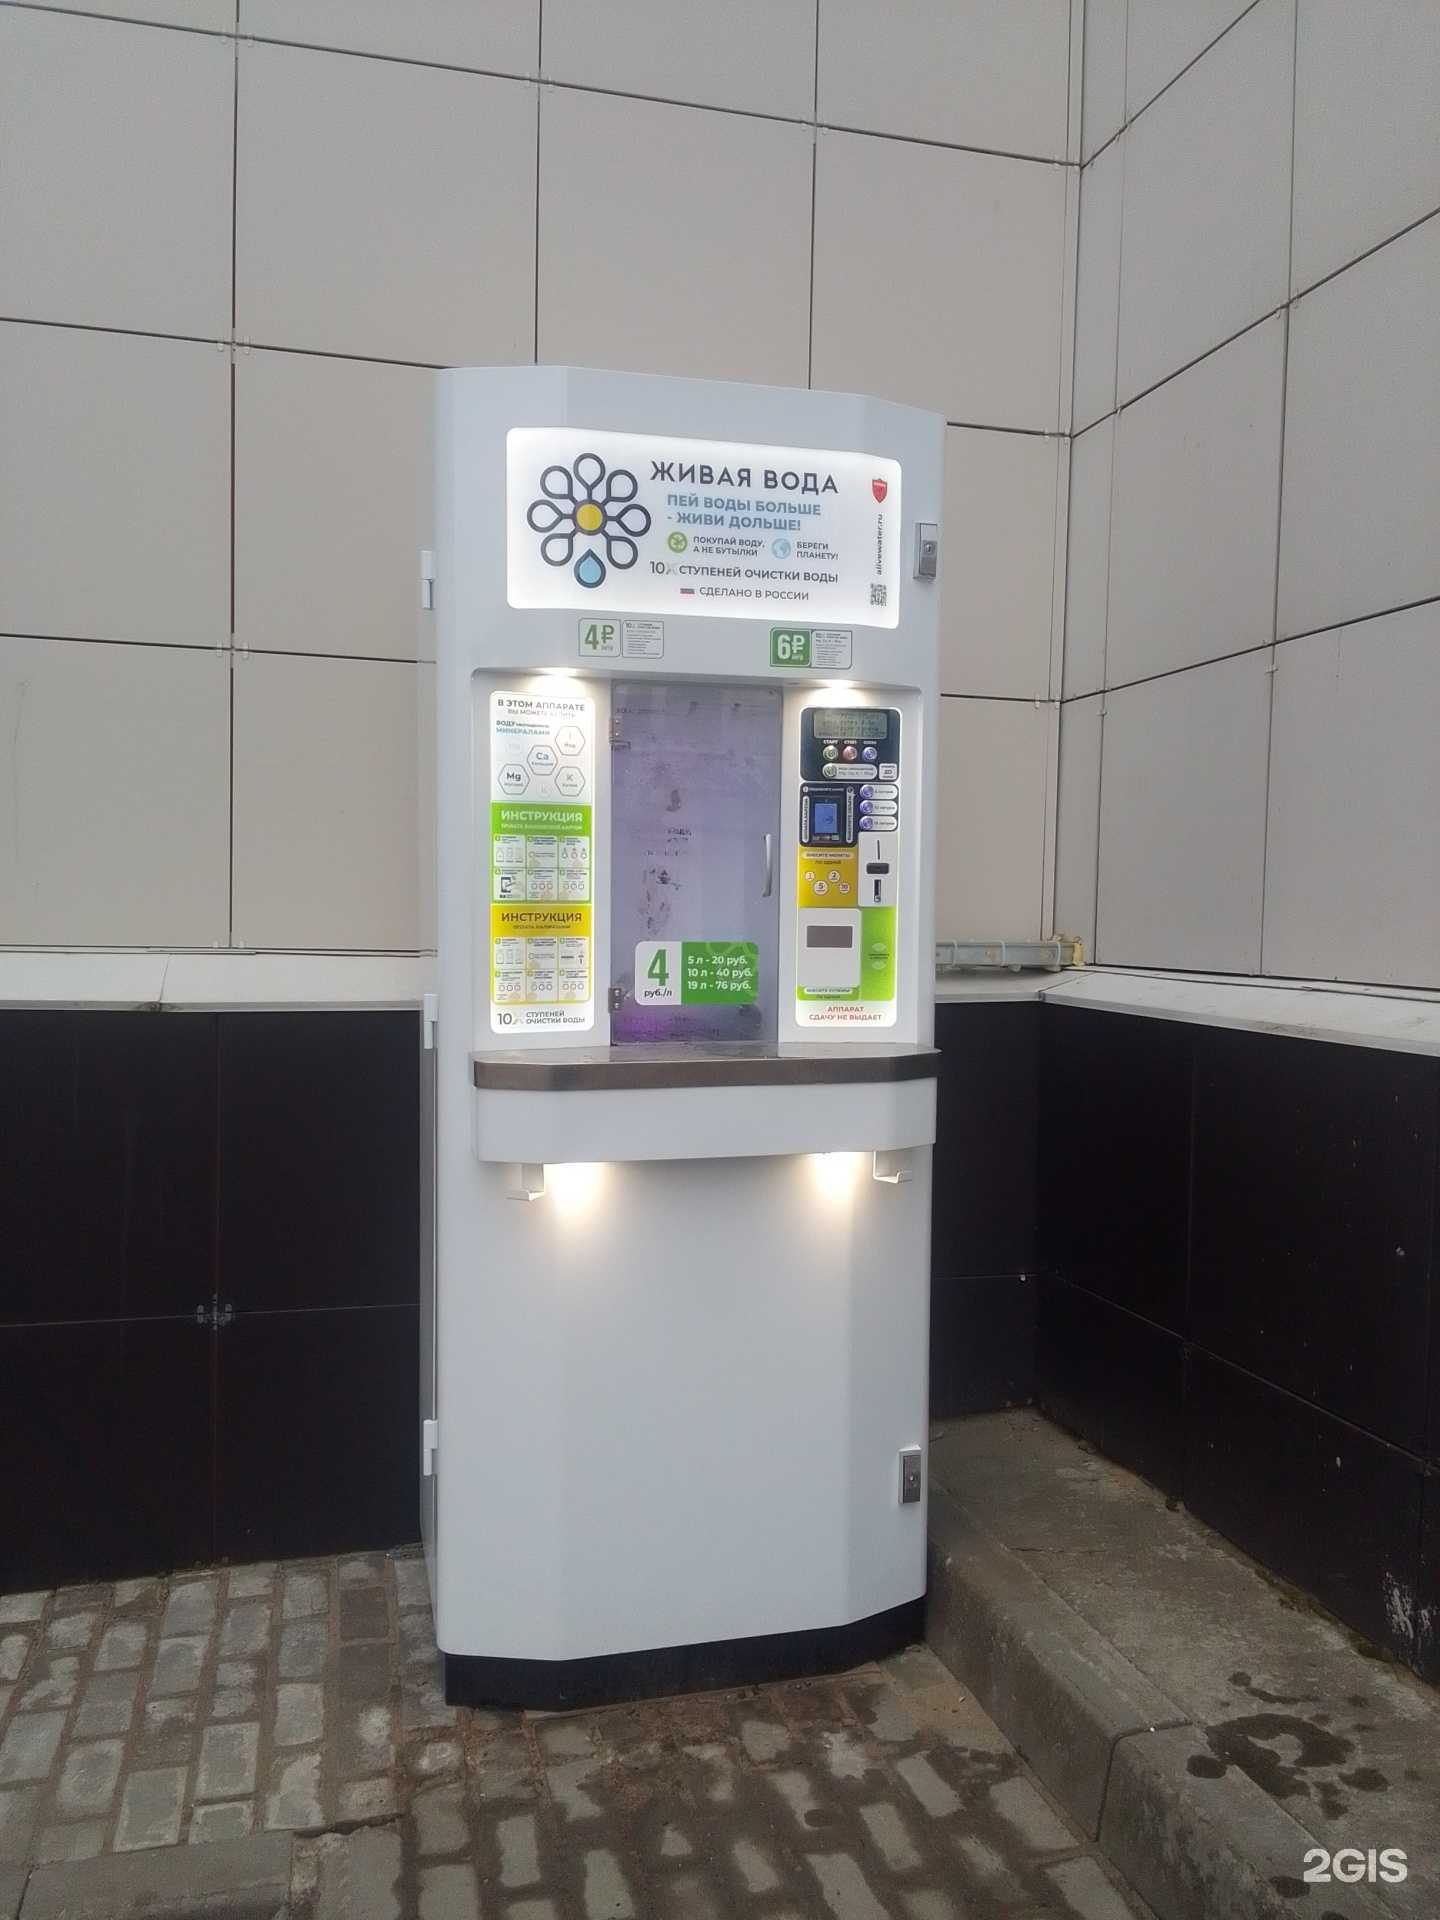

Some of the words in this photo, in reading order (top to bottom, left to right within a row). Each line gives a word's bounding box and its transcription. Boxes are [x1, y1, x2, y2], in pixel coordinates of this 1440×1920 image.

[650, 461, 751, 488] ЖИВАЯ
[763, 470, 839, 495] ВОДА
[667, 493, 701, 508] ПЕЙ
[704, 497, 751, 512] ВОДЫ
[755, 501, 822, 516] БОЛЬШЕ
[677, 512, 725, 527] ЖИВИ
[729, 516, 801, 531] ДОЛЬШЕ!
[693, 536, 737, 547] ПОКУПАЙ
[797, 541, 829, 551] БЕРЕГИ
[693, 546, 700, 554] А
[701, 547, 714, 555] НЕ
[715, 547, 758, 557] БУТЫЛКИ
[797, 551, 839, 561] ПЛАНЕТУ!
[650, 561, 665, 575] 10
[679, 565, 741, 579] СТУПЕНЕЙ
[745, 567, 800, 581] ОЧИСТКИ
[803, 572, 838, 584] ВОДЫ
[700, 587, 752, 599] СДЕЛАНО
[755, 590, 762, 598] В
[765, 590, 809, 601] РОССИИ
[498, 699, 504, 707] В
[506, 700, 532, 708] ЭТОМ
[536, 702, 585, 711] АППАРАТЕ
[536, 752, 549, 760] Ca
[507, 772, 521, 781] Mg
[501, 810, 583, 823] ИНСТРУКЦИЯ
[502, 912, 582, 923] ИНСТРУКЦИЯ
[688, 956, 694, 964] 5
[711, 956, 725, 964] 20
[726, 955, 748, 966] руб.
[648, 949, 669, 986] 4
[688, 968, 698, 977] 10
[716, 968, 729, 977] 40
[732, 967, 753, 979] руб.
[688, 981, 698, 989] 19
[715, 981, 728, 989] 76
[730, 980, 752, 991] руб.
[497, 1013, 512, 1025] 10
[526, 1010, 565, 1018] СТУПЕНЕЙ
[526, 1017, 562, 1025] ОЧИСТКИ
